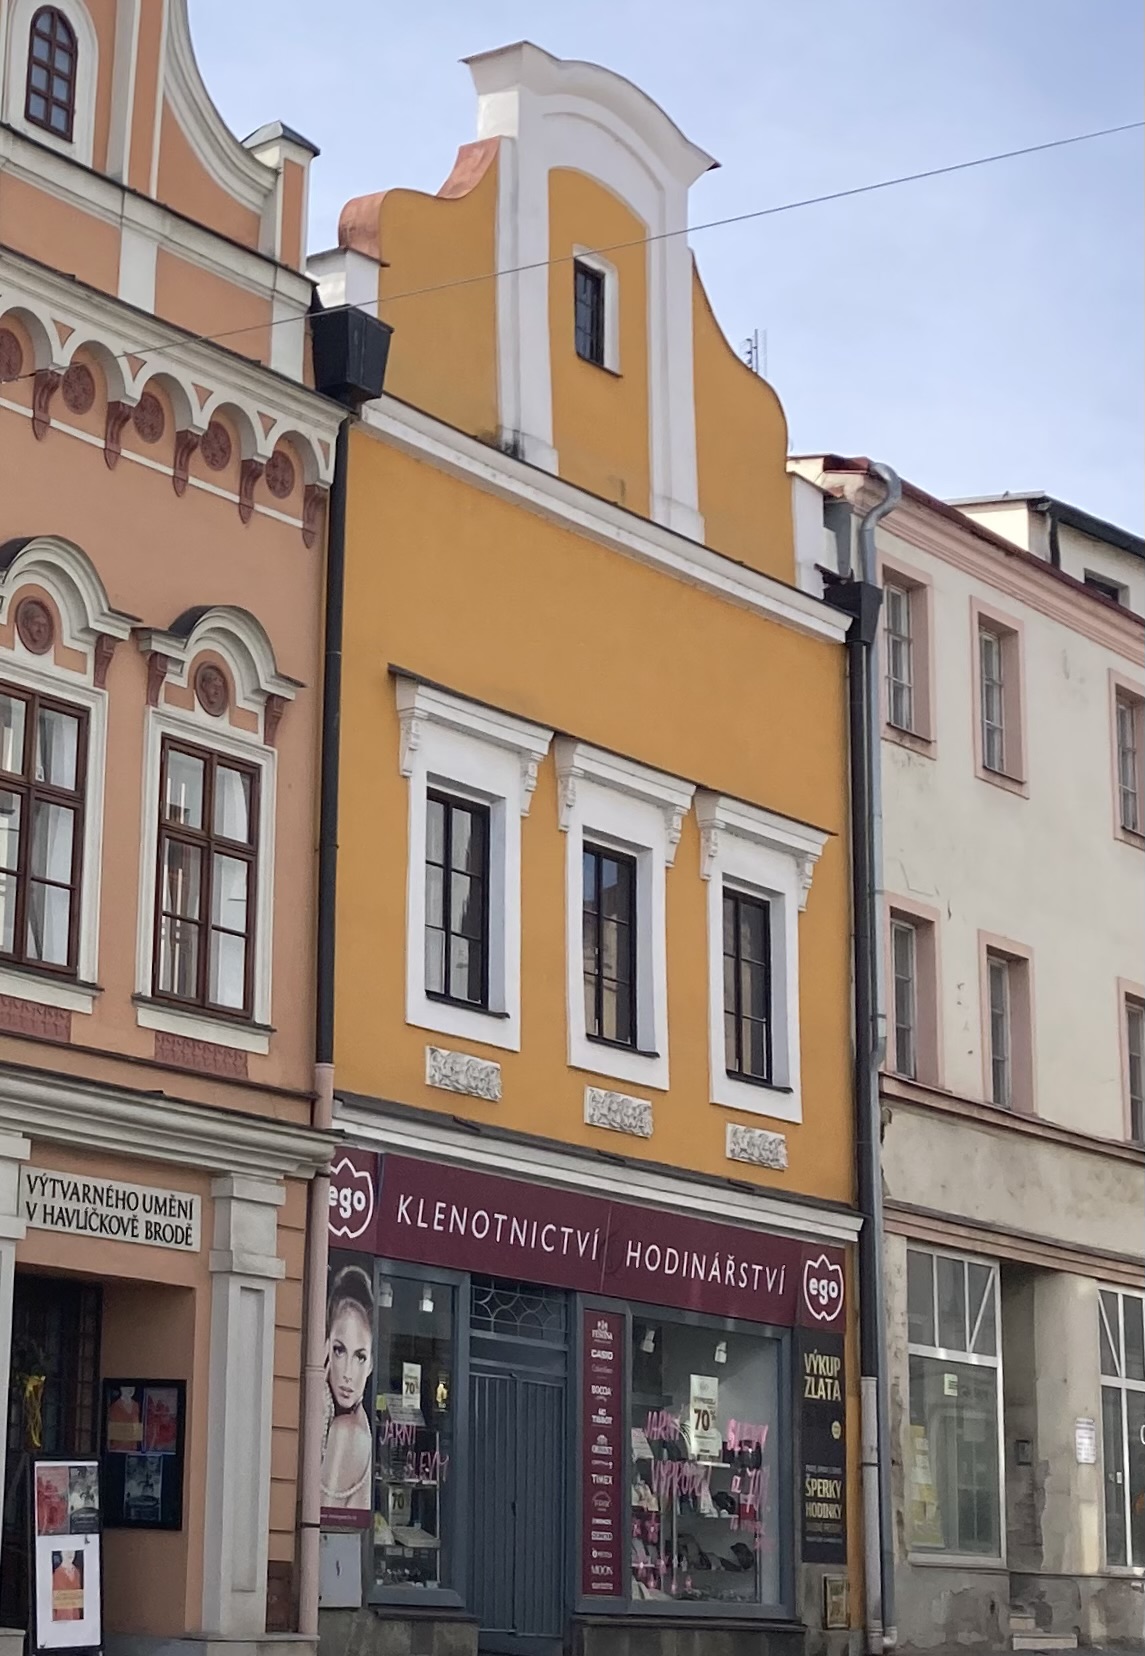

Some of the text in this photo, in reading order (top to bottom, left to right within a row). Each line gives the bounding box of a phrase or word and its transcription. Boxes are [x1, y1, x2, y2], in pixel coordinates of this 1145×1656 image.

[27, 1173, 194, 1220] VÝTVARNÉHO UMĚNÍ
[26, 1201, 193, 1246] V HAVLÍČKOVĚ BRODĚ
[397, 1194, 787, 1295] KLENOTNICTVÍ HODINÁŘSTVÍ
[808, 1277, 839, 1305] ego
[591, 1349, 613, 1360] CASIO
[804, 1348, 841, 1377] VÝKUP
[804, 1376, 841, 1401] ZLATA
[805, 1473, 842, 1499] ŠPERKY
[805, 1501, 842, 1519] HODINKY
